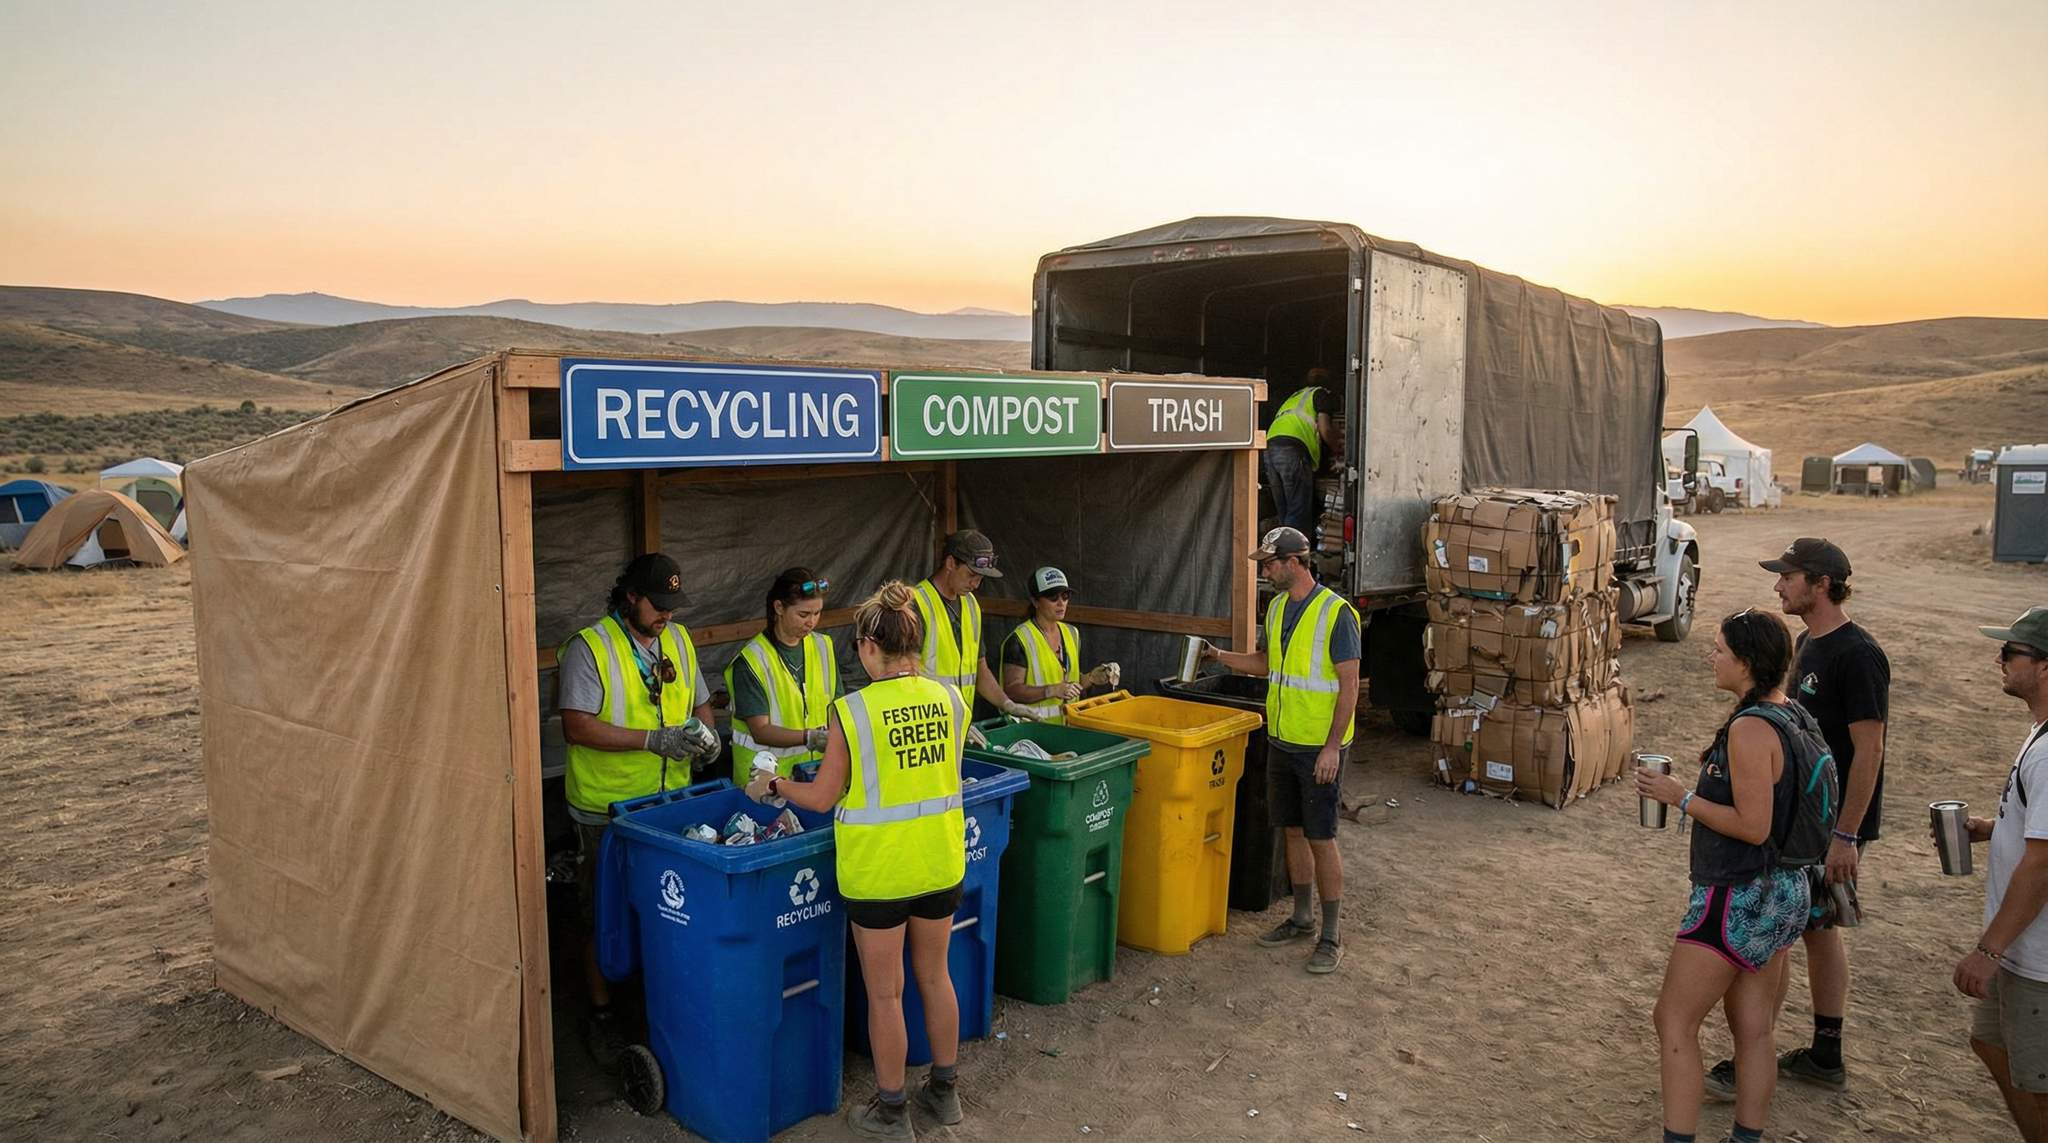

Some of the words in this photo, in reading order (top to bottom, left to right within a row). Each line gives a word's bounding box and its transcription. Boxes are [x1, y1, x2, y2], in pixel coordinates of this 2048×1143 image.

[597, 387, 860, 440] RECYCLING
[922, 394, 1079, 437] COMPOST
[1148, 397, 1223, 433] TRASH
[882, 702, 948, 726] FESTIVAL
[888, 720, 949, 748] GREEN
[895, 743, 946, 770] TEAM
[776, 900, 831, 929] RECYCLING
